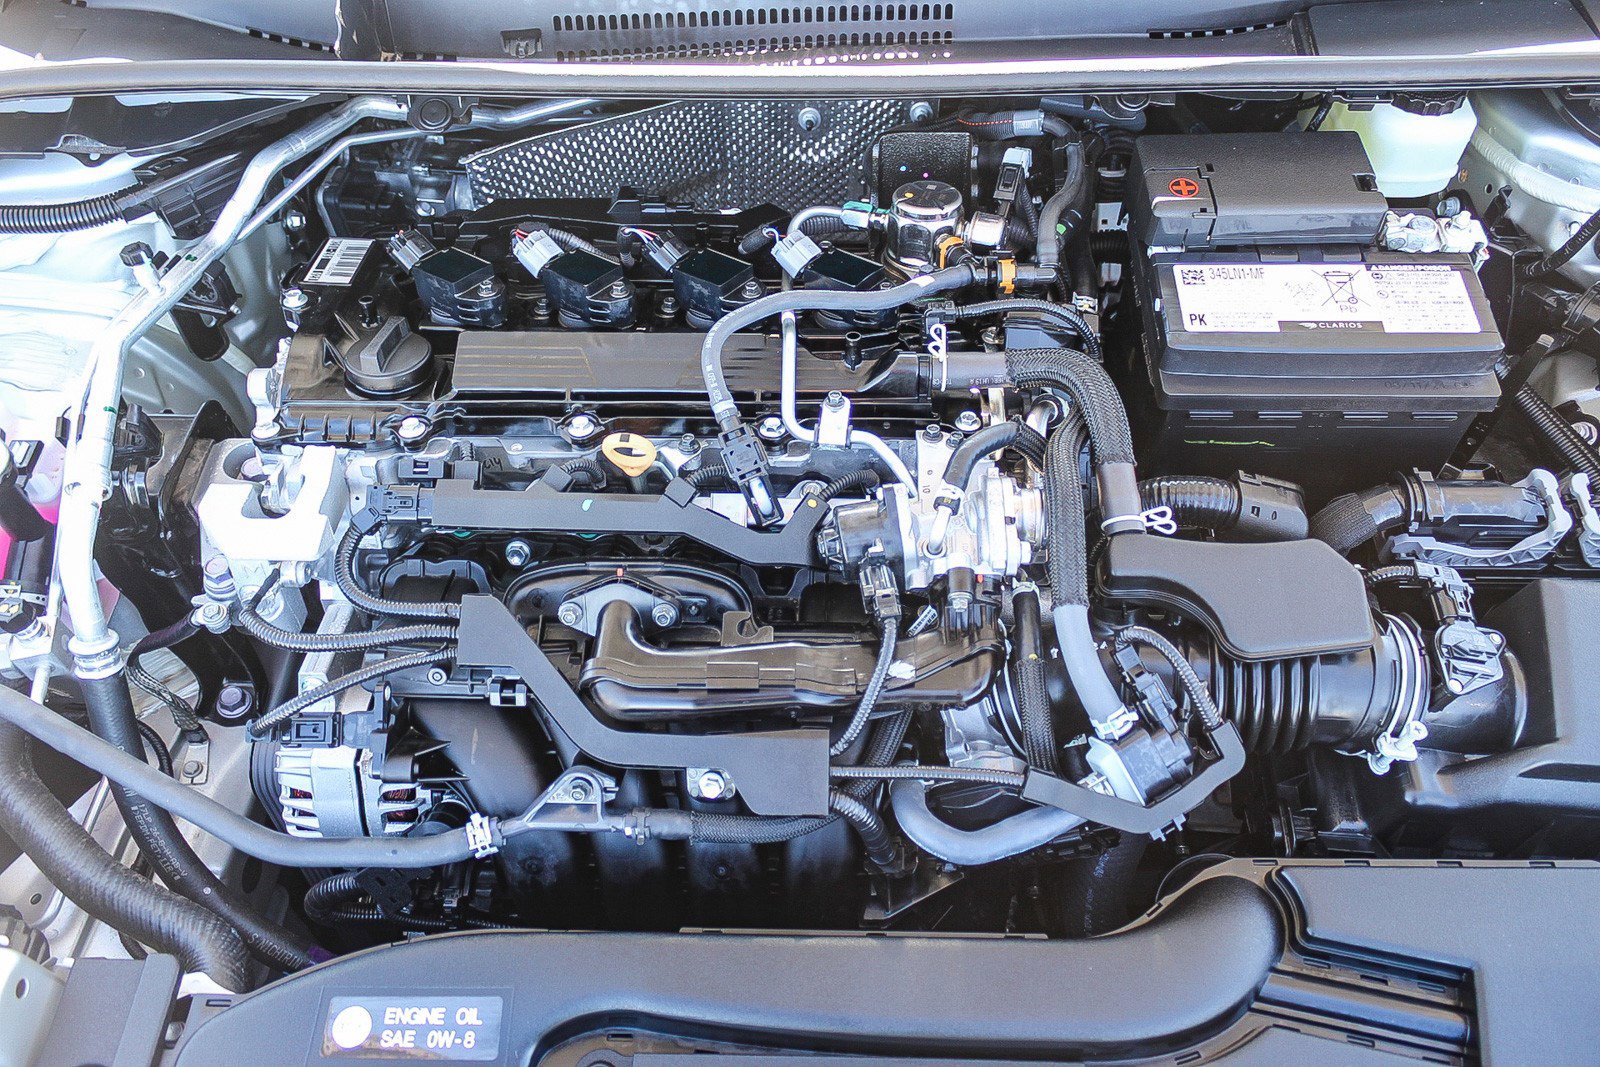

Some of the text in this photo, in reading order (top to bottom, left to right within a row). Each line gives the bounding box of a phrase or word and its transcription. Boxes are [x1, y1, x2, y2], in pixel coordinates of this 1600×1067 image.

[1209, 267, 1264, 279] 345LN1-MF
[1189, 313, 1207, 326] PK
[384, 1007, 483, 1025] ENGINE OIL
[380, 1029, 476, 1049] SAE 0W-8
